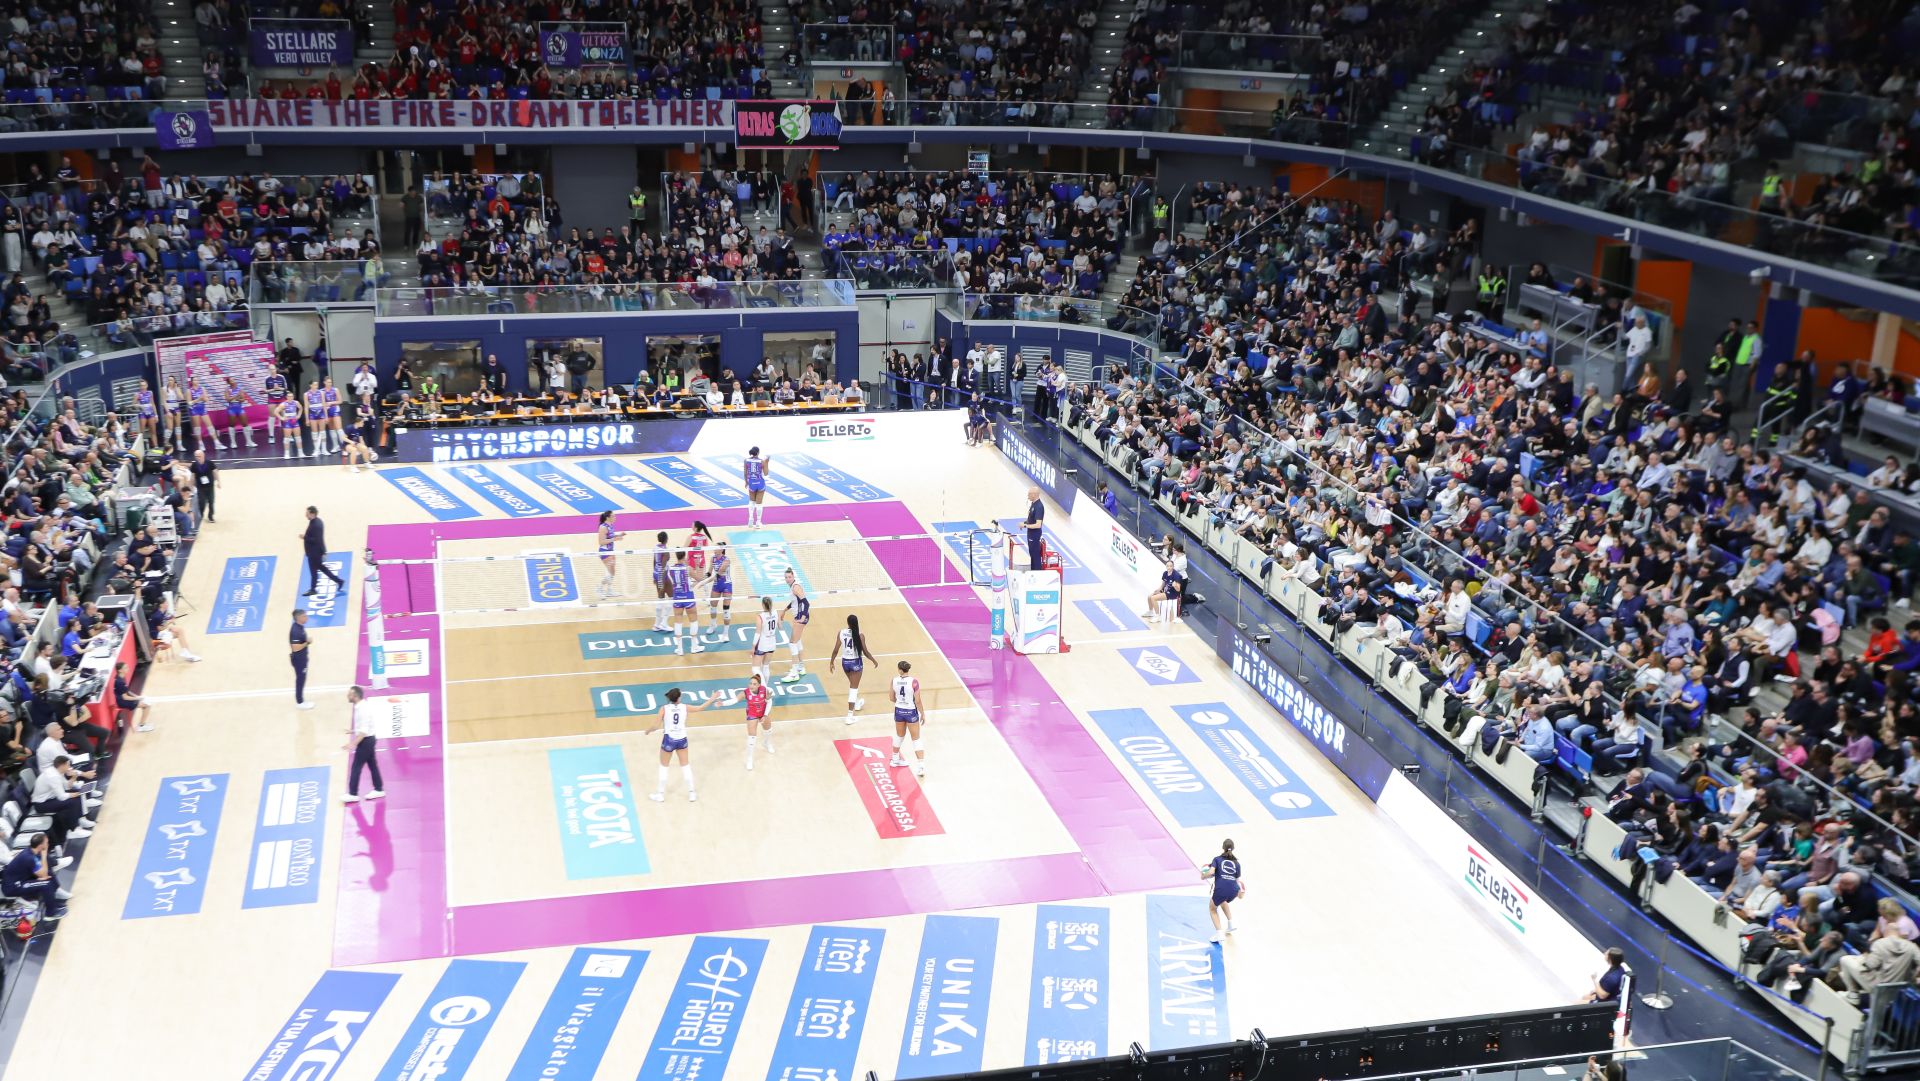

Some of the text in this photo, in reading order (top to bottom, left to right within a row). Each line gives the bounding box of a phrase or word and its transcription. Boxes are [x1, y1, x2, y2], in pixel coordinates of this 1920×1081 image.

[266, 32, 337, 50] STELLARS
[581, 34, 620, 47] ULTRAS
[274, 52, 332, 64] VERO VOLLEY
[209, 100, 313, 126] SHARE
[322, 100, 380, 126] THE
[577, 101, 724, 127] TOGETHER
[737, 111, 775, 136] ULTRAS
[810, 424, 871, 437] DELLORTO
[431, 424, 635, 462] MATCHSPONSOR
[1002, 425, 1057, 489] MATCHSPONSOR
[768, 620, 776, 631] 10
[844, 637, 853, 649] 14
[1145, 656, 1172, 675] IBSA
[900, 685, 906, 698] 4
[1232, 634, 1347, 754] MATCHSPONSOR
[673, 713, 679, 725] 9
[1119, 736, 1205, 795] COLMAR
[178, 795, 200, 814] TXT
[296, 781, 321, 824] CONTECO
[867, 760, 918, 833] FRECCIAROSSA
[165, 839, 190, 860] TXT
[288, 838, 315, 887] CONTECO
[1468, 856, 1524, 921] DELLORTO
[152, 888, 177, 912] TXT
[924, 957, 936, 973] YOUR
[921, 973, 933, 985] KEY
[1158, 930, 1217, 1027] ARVAL
[580, 987, 604, 997] il
[916, 985, 931, 1012] PARTNER
[296, 1009, 319, 1020] LA
[914, 1011, 926, 1025] FOR
[930, 958, 978, 1057] UNIKA
[279, 1021, 309, 1041] TUA
[672, 999, 710, 1047] HOTEL
[698, 1001, 735, 1047] EURO
